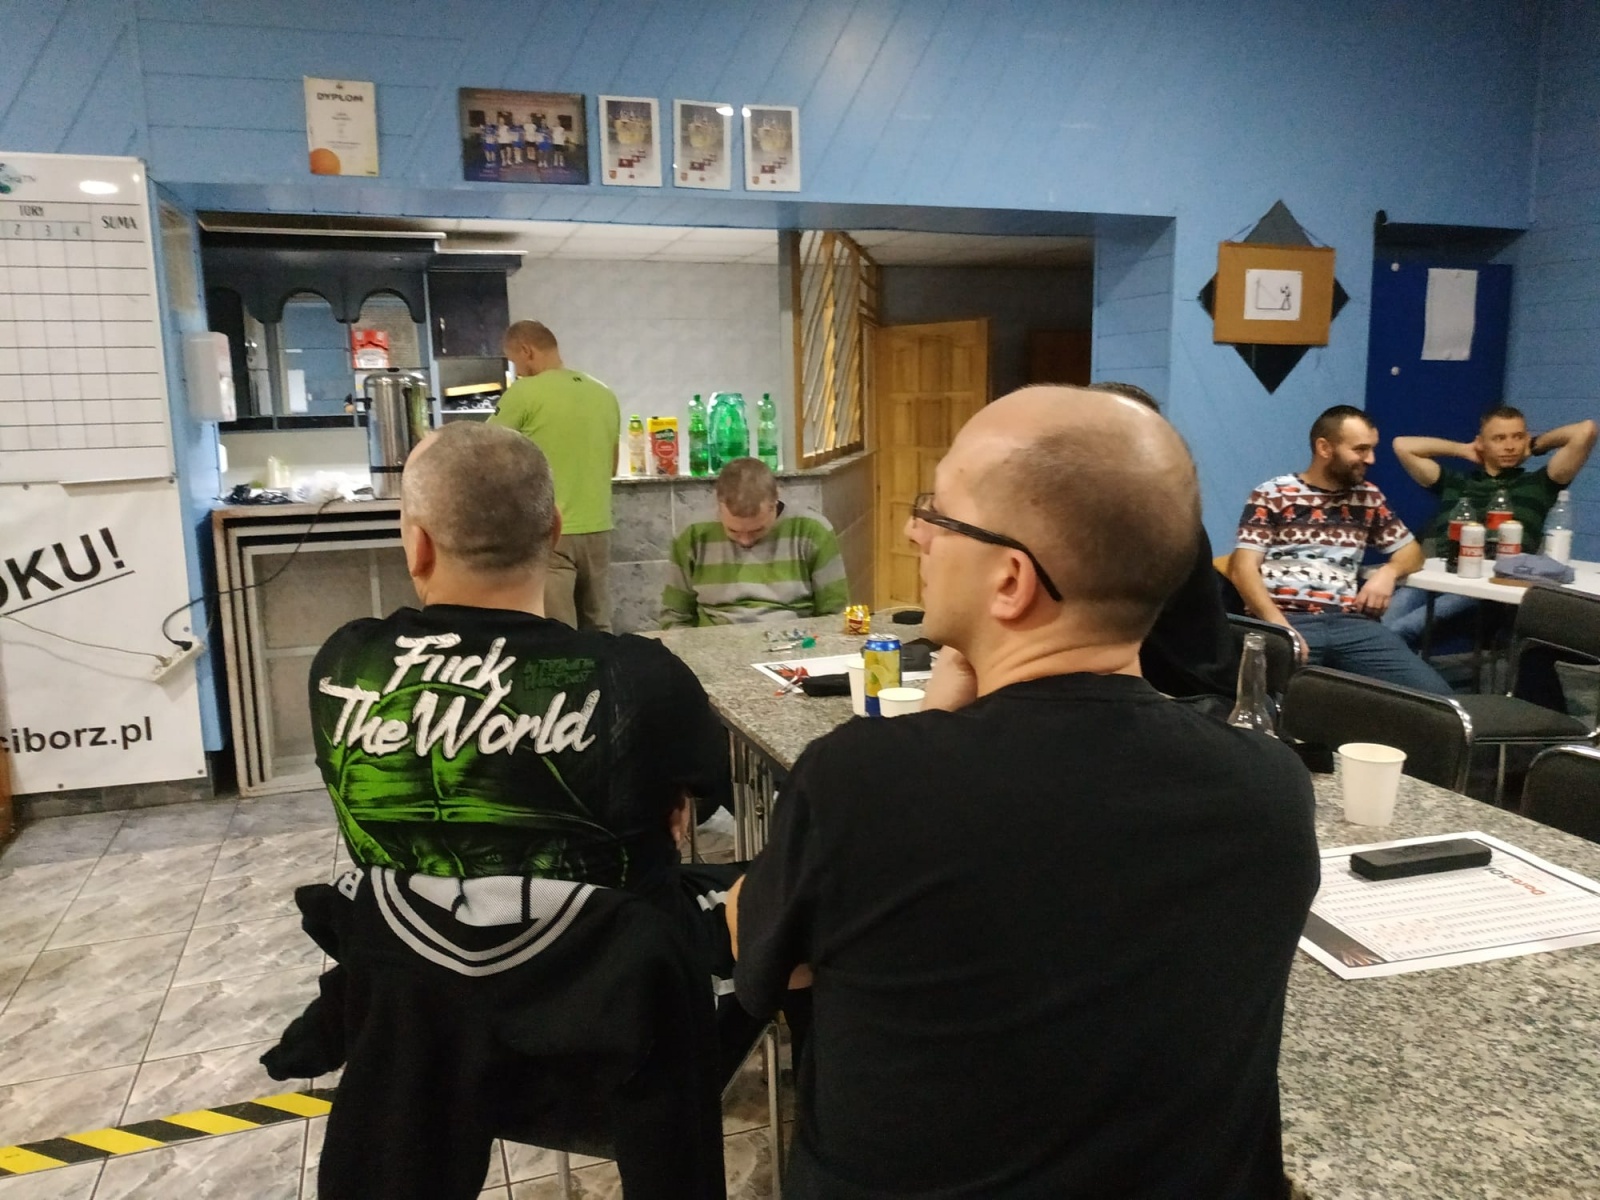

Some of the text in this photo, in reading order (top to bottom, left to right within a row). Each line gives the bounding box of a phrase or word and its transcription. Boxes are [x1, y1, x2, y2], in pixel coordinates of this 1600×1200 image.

[102, 215, 138, 230] SUMA
[44, 224, 53, 237] 3
[319, 676, 601, 759] The World
